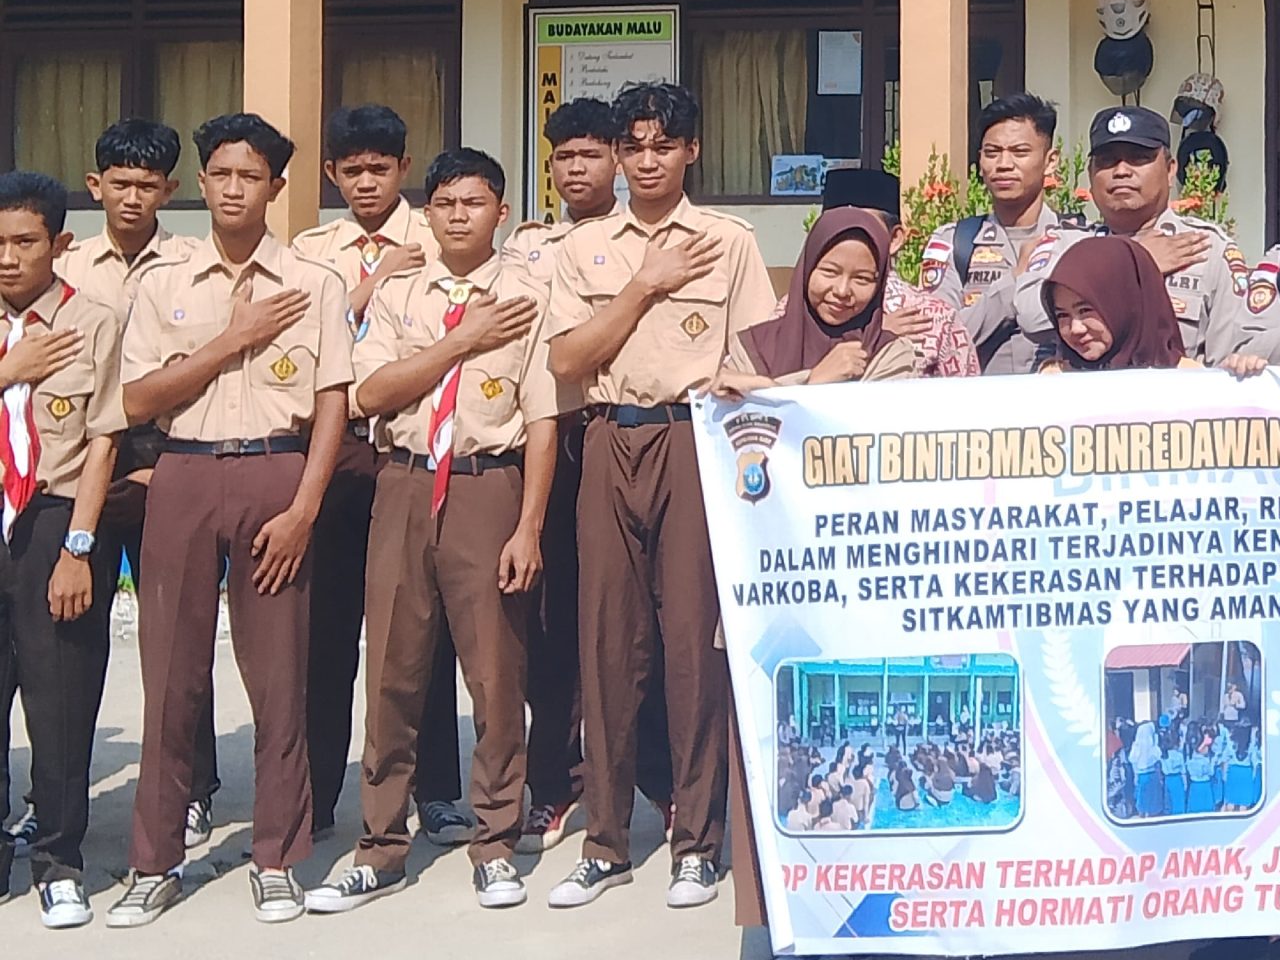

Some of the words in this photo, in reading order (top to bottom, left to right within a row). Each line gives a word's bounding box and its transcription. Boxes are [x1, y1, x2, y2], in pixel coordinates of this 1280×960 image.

[547, 22, 623, 37] BUDAYAKAN
[626, 21, 662, 34] MALU
[803, 434, 874, 488] GIAT
[878, 426, 1066, 482] BINTIBMAS
[816, 510, 898, 537] PERAN
[911, 503, 1106, 533] MASYARAKAT,
[1119, 497, 1247, 525] PELAJAR,
[760, 546, 835, 572] DALAM
[847, 538, 1036, 569] MENGHINDARI
[1049, 531, 1222, 559] TERJADINYA
[858, 574, 943, 600] SERTA
[955, 568, 1120, 596] KEKERASAN
[1133, 562, 1276, 590] TERHADAP
[902, 601, 1111, 632] SITKAMTIBMAS
[1123, 598, 1199, 623] YANG
[815, 862, 986, 892] KEKERASAN
[997, 854, 1156, 888] TERHADAP
[1164, 848, 1252, 880] ANAK,
[893, 900, 985, 928] SERTA
[995, 896, 1133, 926] HORMATI
[1143, 885, 1244, 917] ORANG
